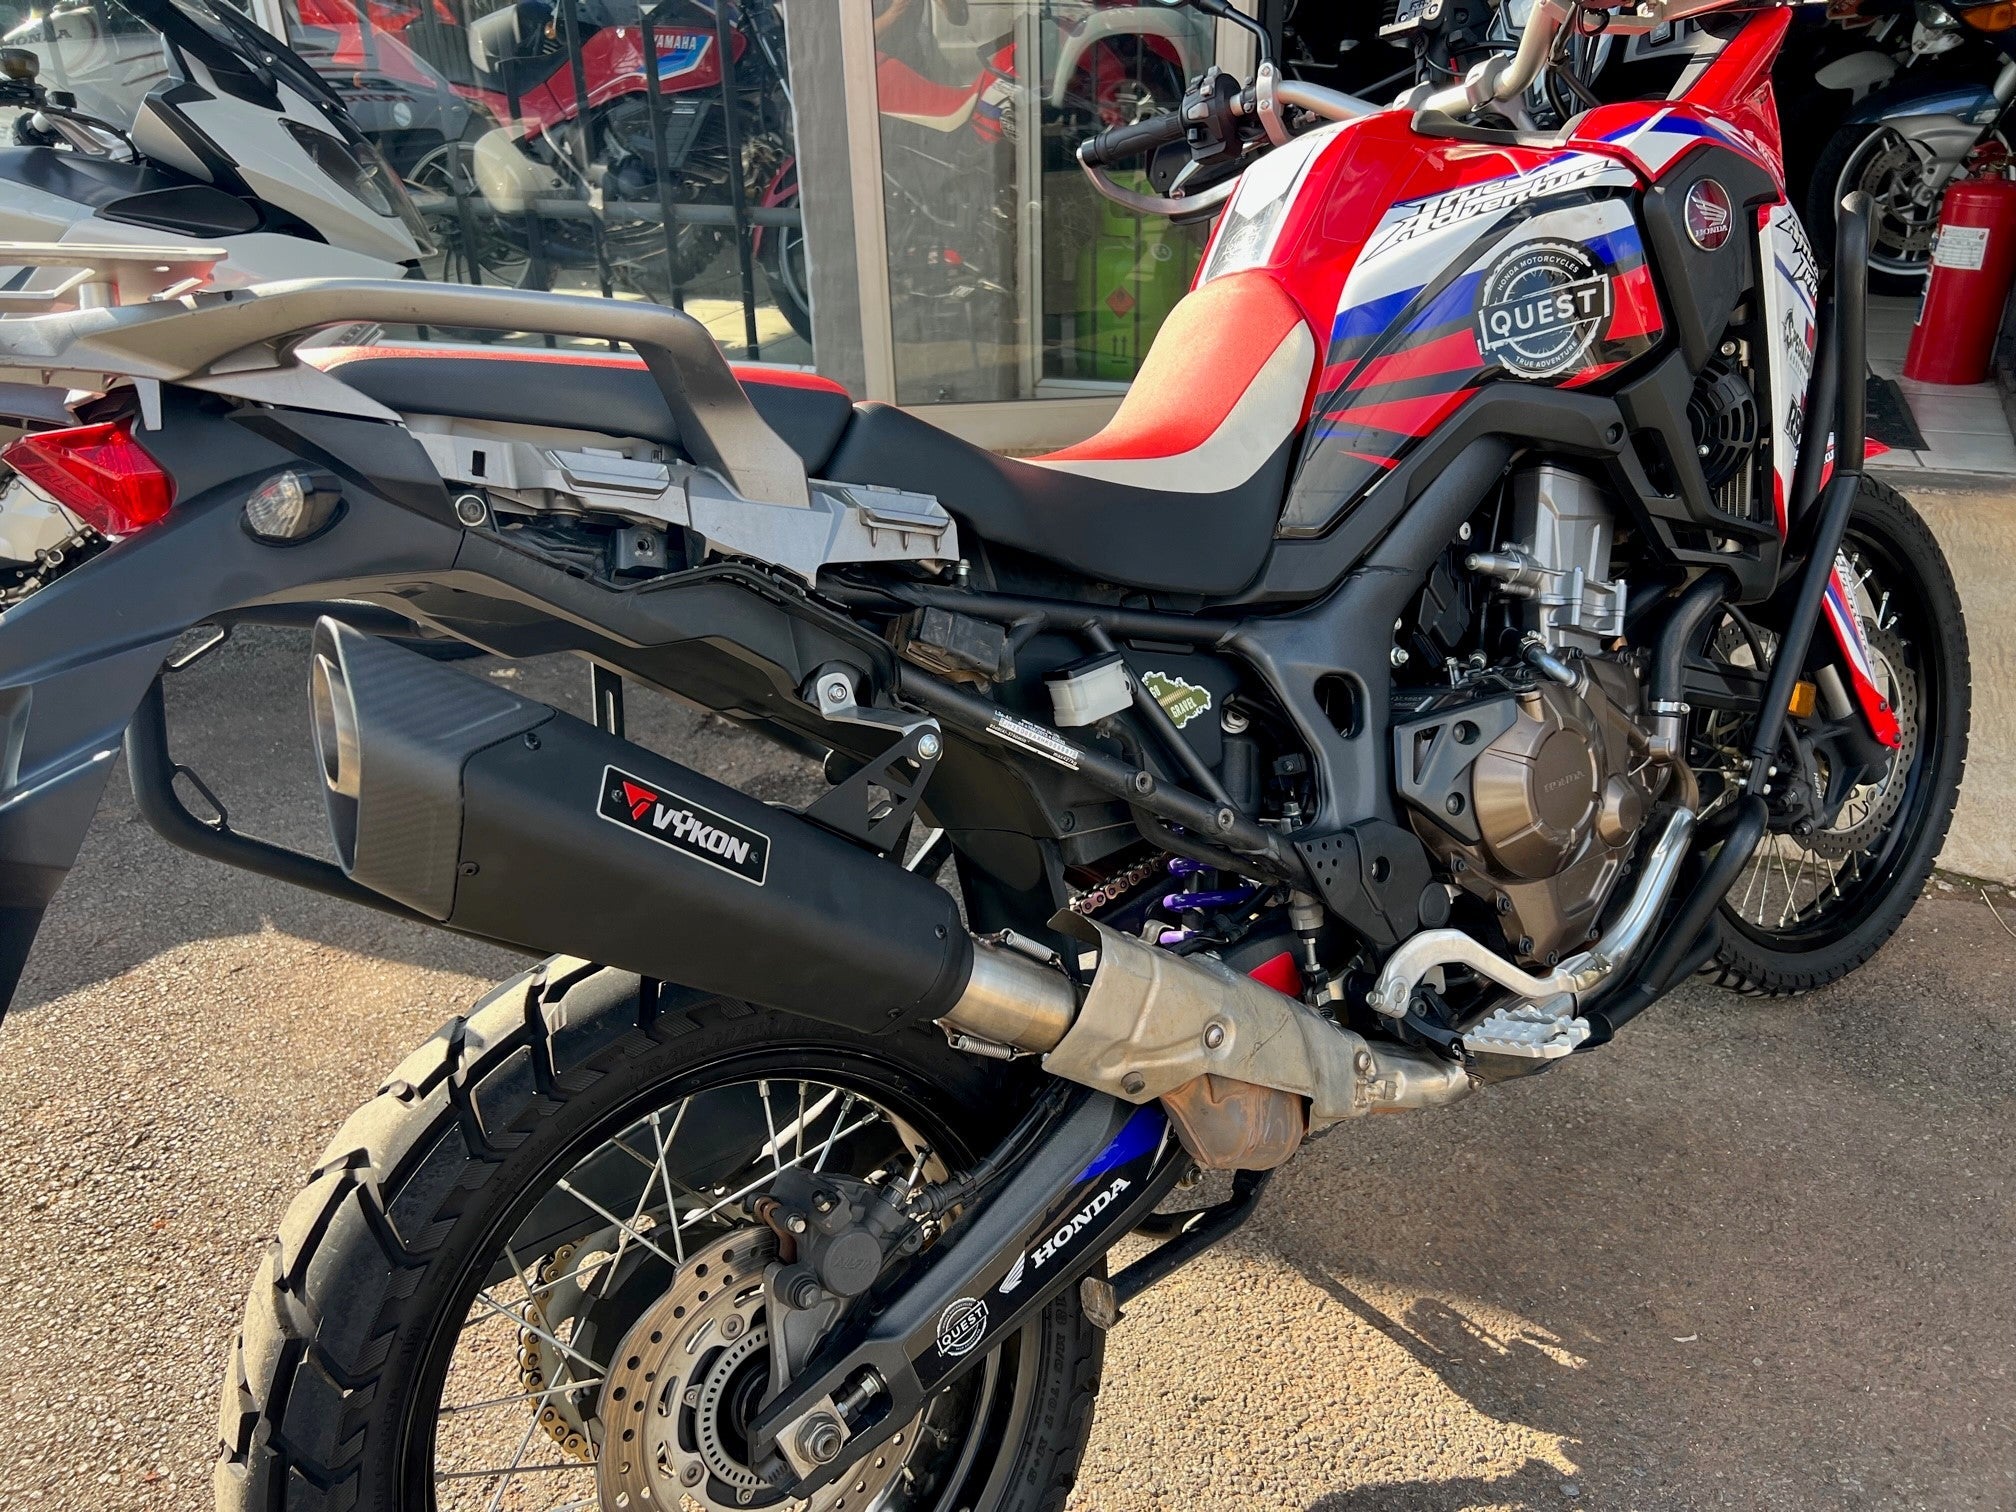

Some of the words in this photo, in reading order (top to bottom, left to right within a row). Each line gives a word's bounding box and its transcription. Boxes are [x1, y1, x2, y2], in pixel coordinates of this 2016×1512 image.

[5, 29, 73, 46] HONA
[1696, 225, 1728, 237] HONDA
[1497, 266, 1519, 291] HONDA
[1520, 255, 1580, 273] MOTORCYCLES
[1490, 288, 1597, 337] QUEST
[1515, 356, 1534, 368] TRUE
[1536, 341, 1578, 368] ADVENTURE
[1170, 697, 1198, 718] GRAVEL
[1031, 1178, 1131, 1269] HONDA
[942, 1307, 982, 1346] QUEST
